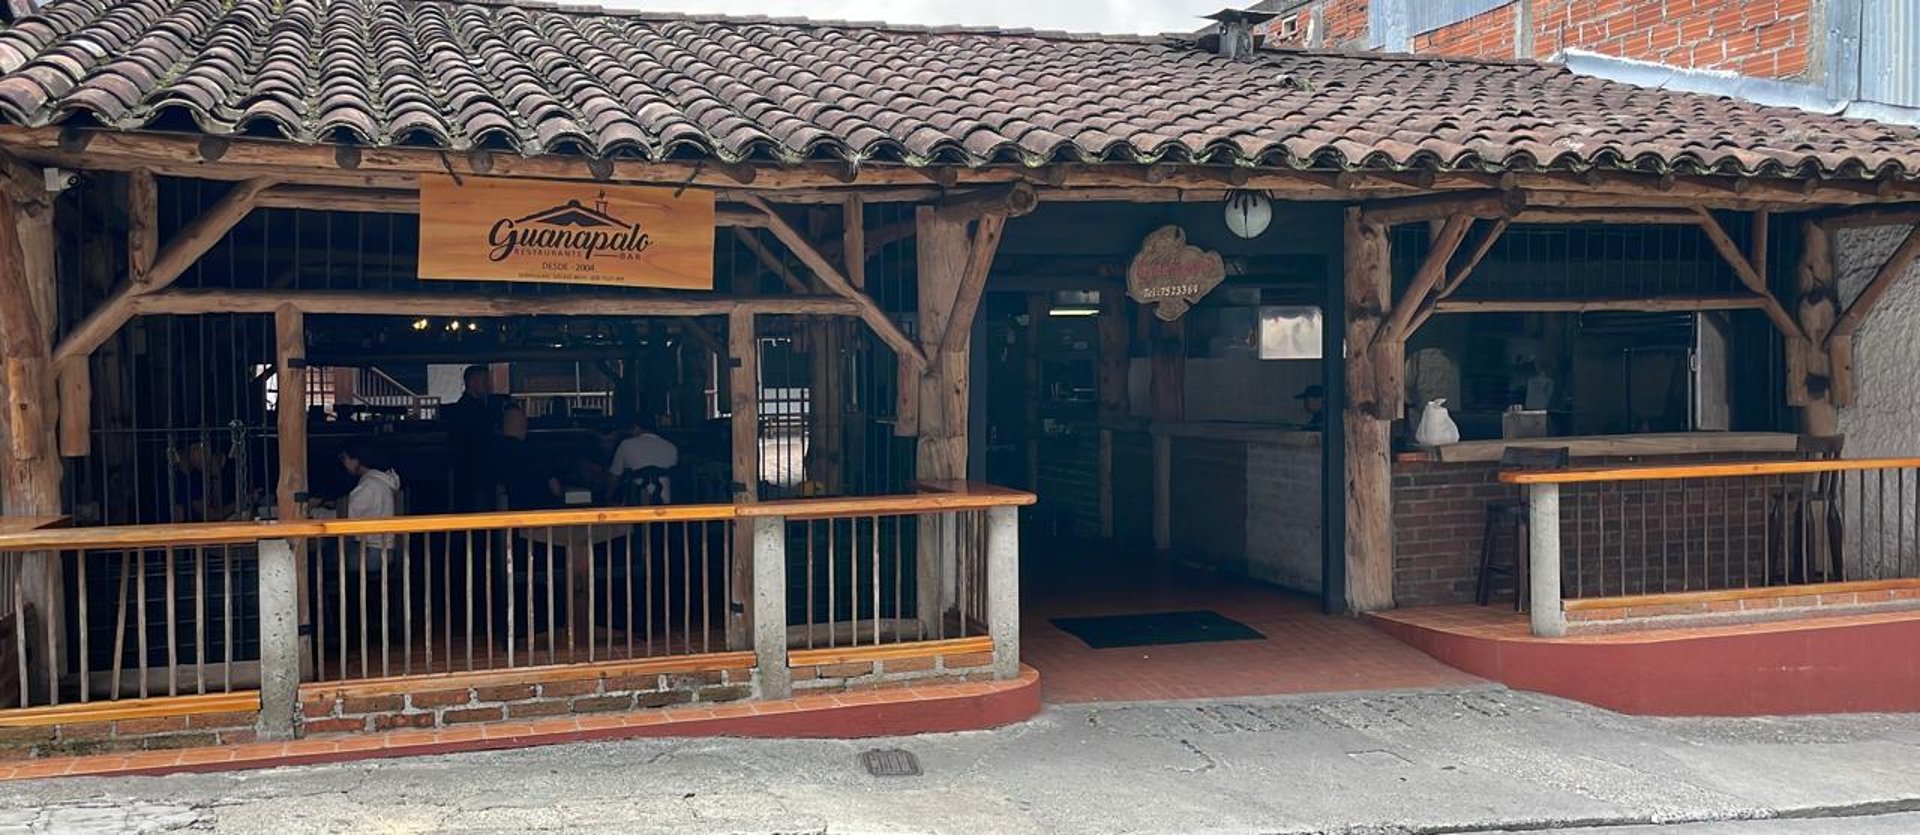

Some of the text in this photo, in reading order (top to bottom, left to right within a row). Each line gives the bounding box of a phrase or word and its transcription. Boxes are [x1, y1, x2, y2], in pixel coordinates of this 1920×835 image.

[489, 218, 649, 261] Guanapalo
[514, 249, 642, 260] RESTAURANTE BAR
[542, 261, 568, 270] DESDE
[575, 263, 595, 272] 2004
